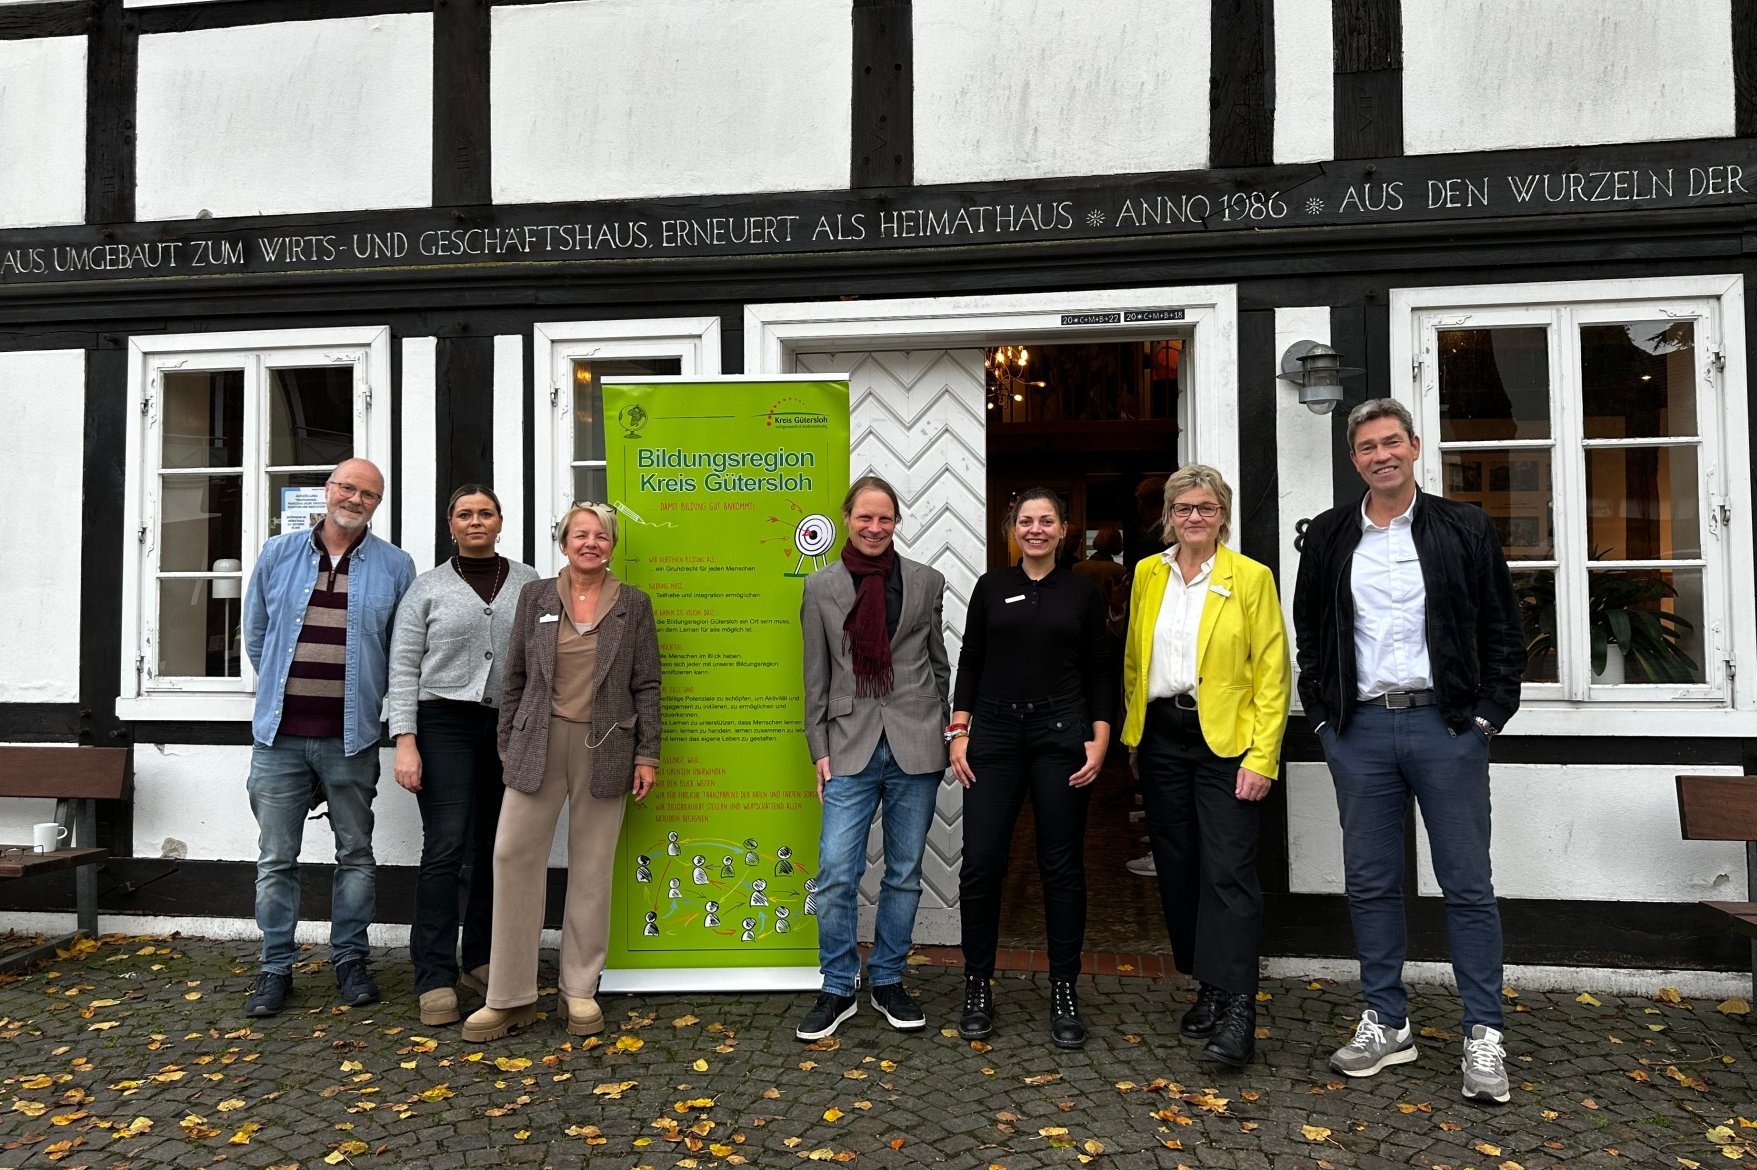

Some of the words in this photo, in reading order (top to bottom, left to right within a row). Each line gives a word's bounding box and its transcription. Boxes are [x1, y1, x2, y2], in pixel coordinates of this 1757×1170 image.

[54, 243, 183, 272] UMGEBAUT
[191, 240, 245, 267] ZUM
[419, 221, 654, 257] GESCHÄFTSHAUS,
[661, 215, 799, 248] ERNEUERT
[812, 213, 866, 241] ALS
[879, 201, 1073, 238] HEIMATHAUS
[1115, 194, 1210, 227] ANNO
[1218, 191, 1287, 222] 1986
[1338, 181, 1404, 213] AUS
[1427, 176, 1489, 209] DEN
[1507, 168, 1674, 203] WURZELN
[1687, 165, 1749, 197] DER
[775, 416, 792, 424] Kreis
[794, 416, 828, 424] Gütersloh
[638, 448, 815, 473] Bildungsregion
[640, 473, 696, 492] Kreis
[704, 473, 813, 492] Gütersloh
[666, 618, 709, 626] Bildungsregion
[736, 661, 778, 669] Bildungsregion
